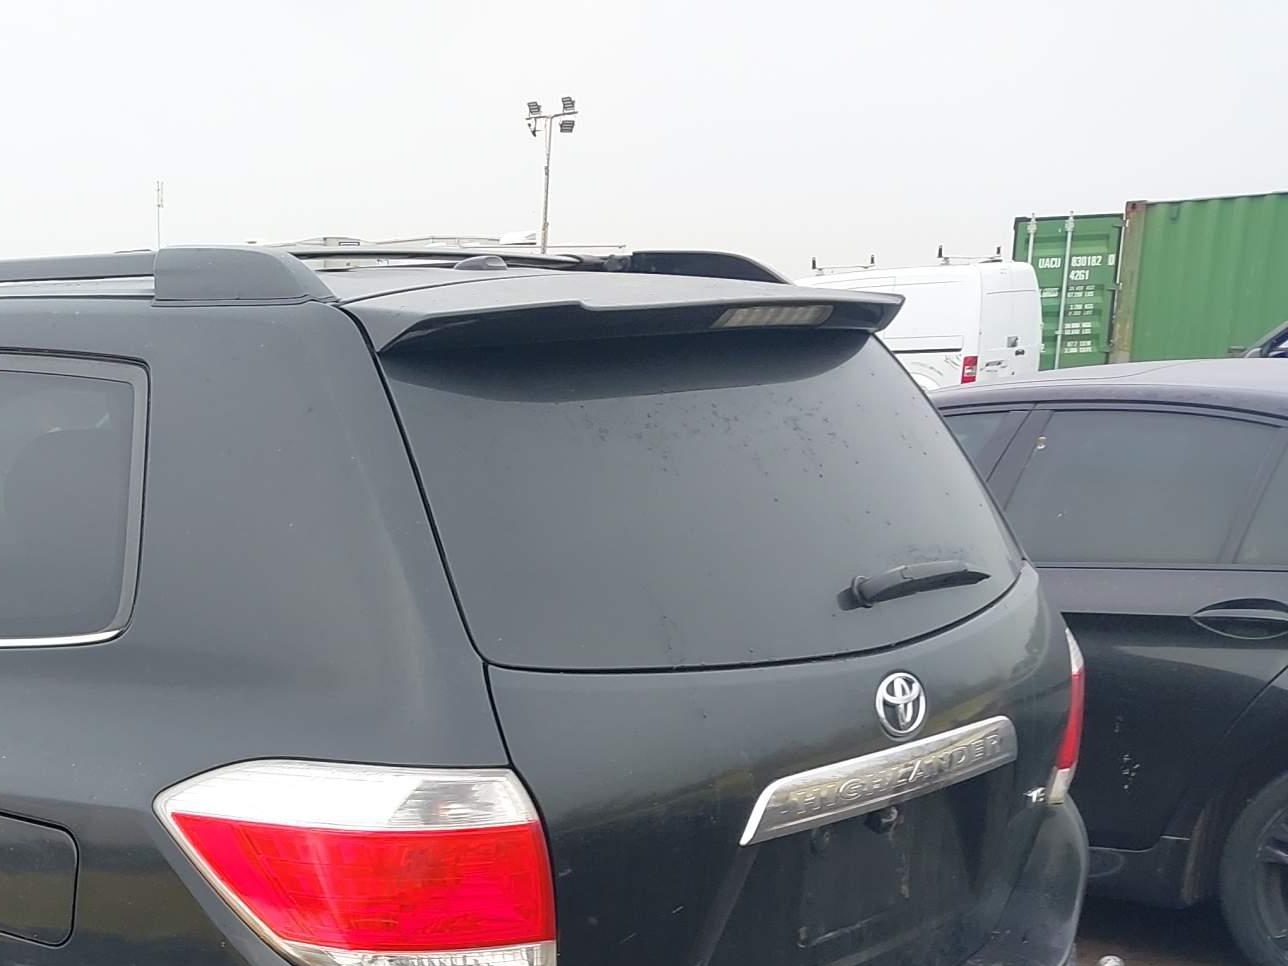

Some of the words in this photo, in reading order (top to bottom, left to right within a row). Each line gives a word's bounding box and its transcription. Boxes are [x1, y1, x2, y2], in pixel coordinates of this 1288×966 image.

[1038, 257, 1061, 268] UACU
[1071, 255, 1102, 267] 830182
[797, 734, 1003, 815] HIGHLANDER
